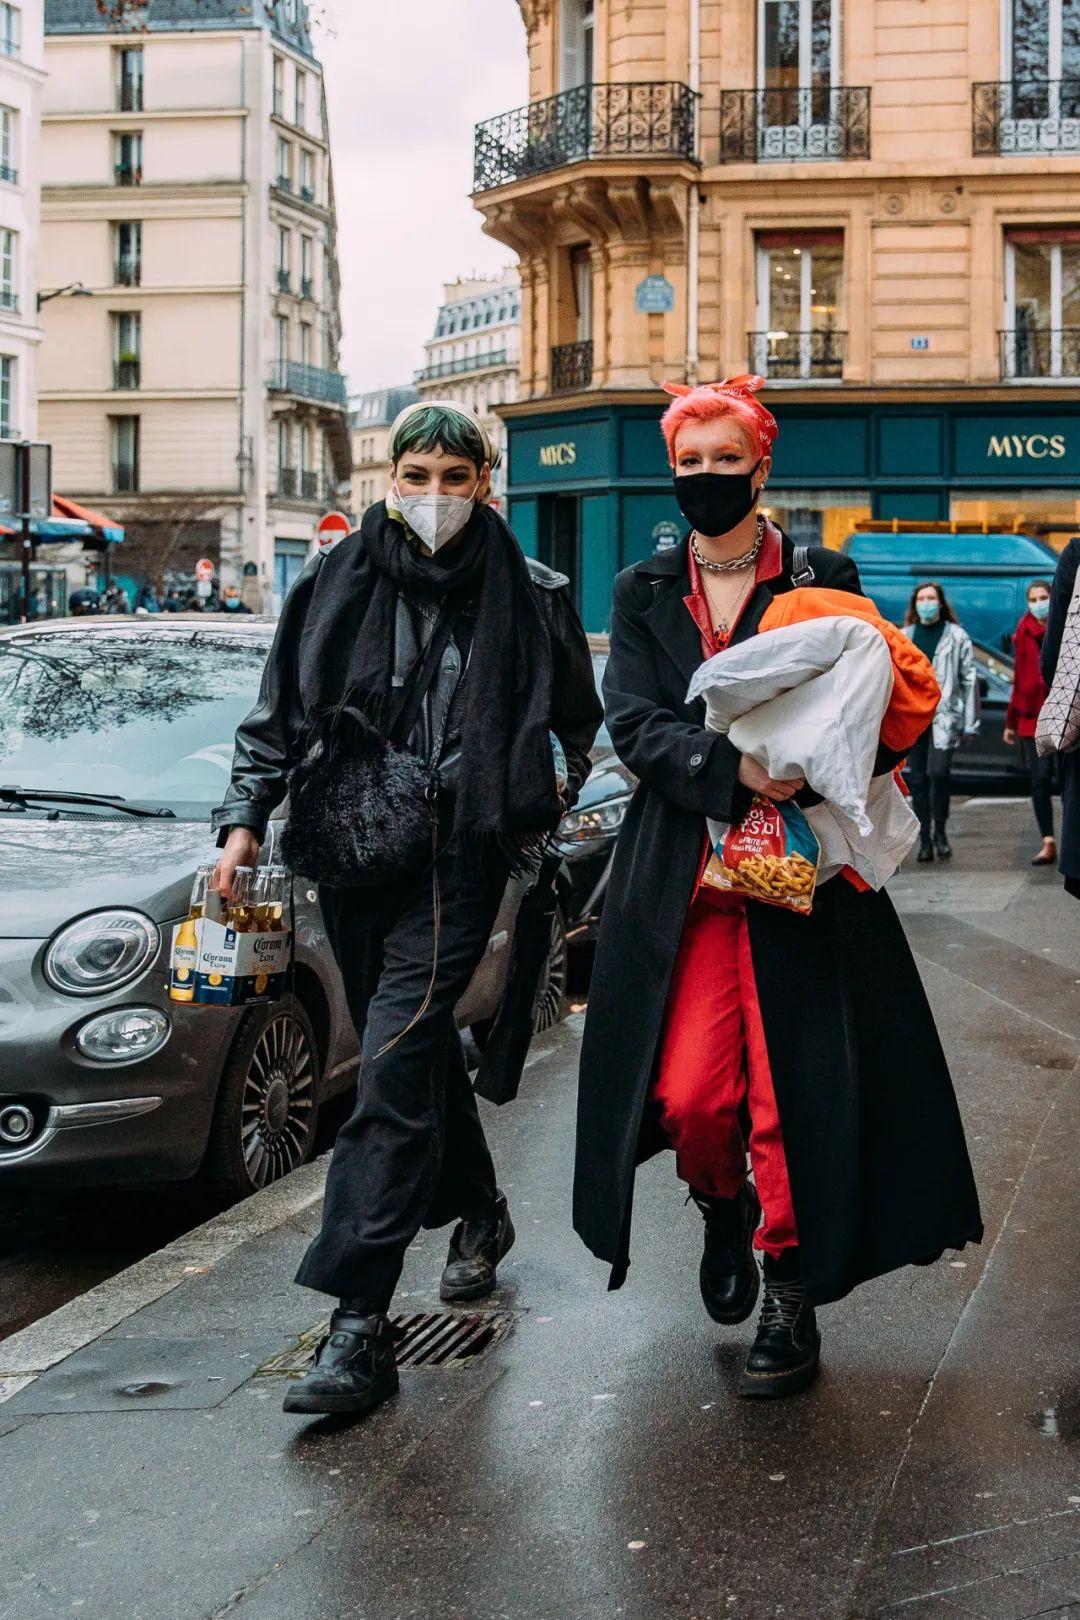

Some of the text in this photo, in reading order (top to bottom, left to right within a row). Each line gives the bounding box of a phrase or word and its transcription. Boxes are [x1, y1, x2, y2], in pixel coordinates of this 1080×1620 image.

[987, 434, 1066, 458] MYCS
[540, 442, 576, 466] MYCS
[228, 934, 234, 942] 6
[254, 937, 282, 953] Corona
[175, 947, 196, 956] Corona
[203, 952, 233, 963] Corona
[259, 952, 274, 962] Extra
[209, 961, 226, 969] Extra
